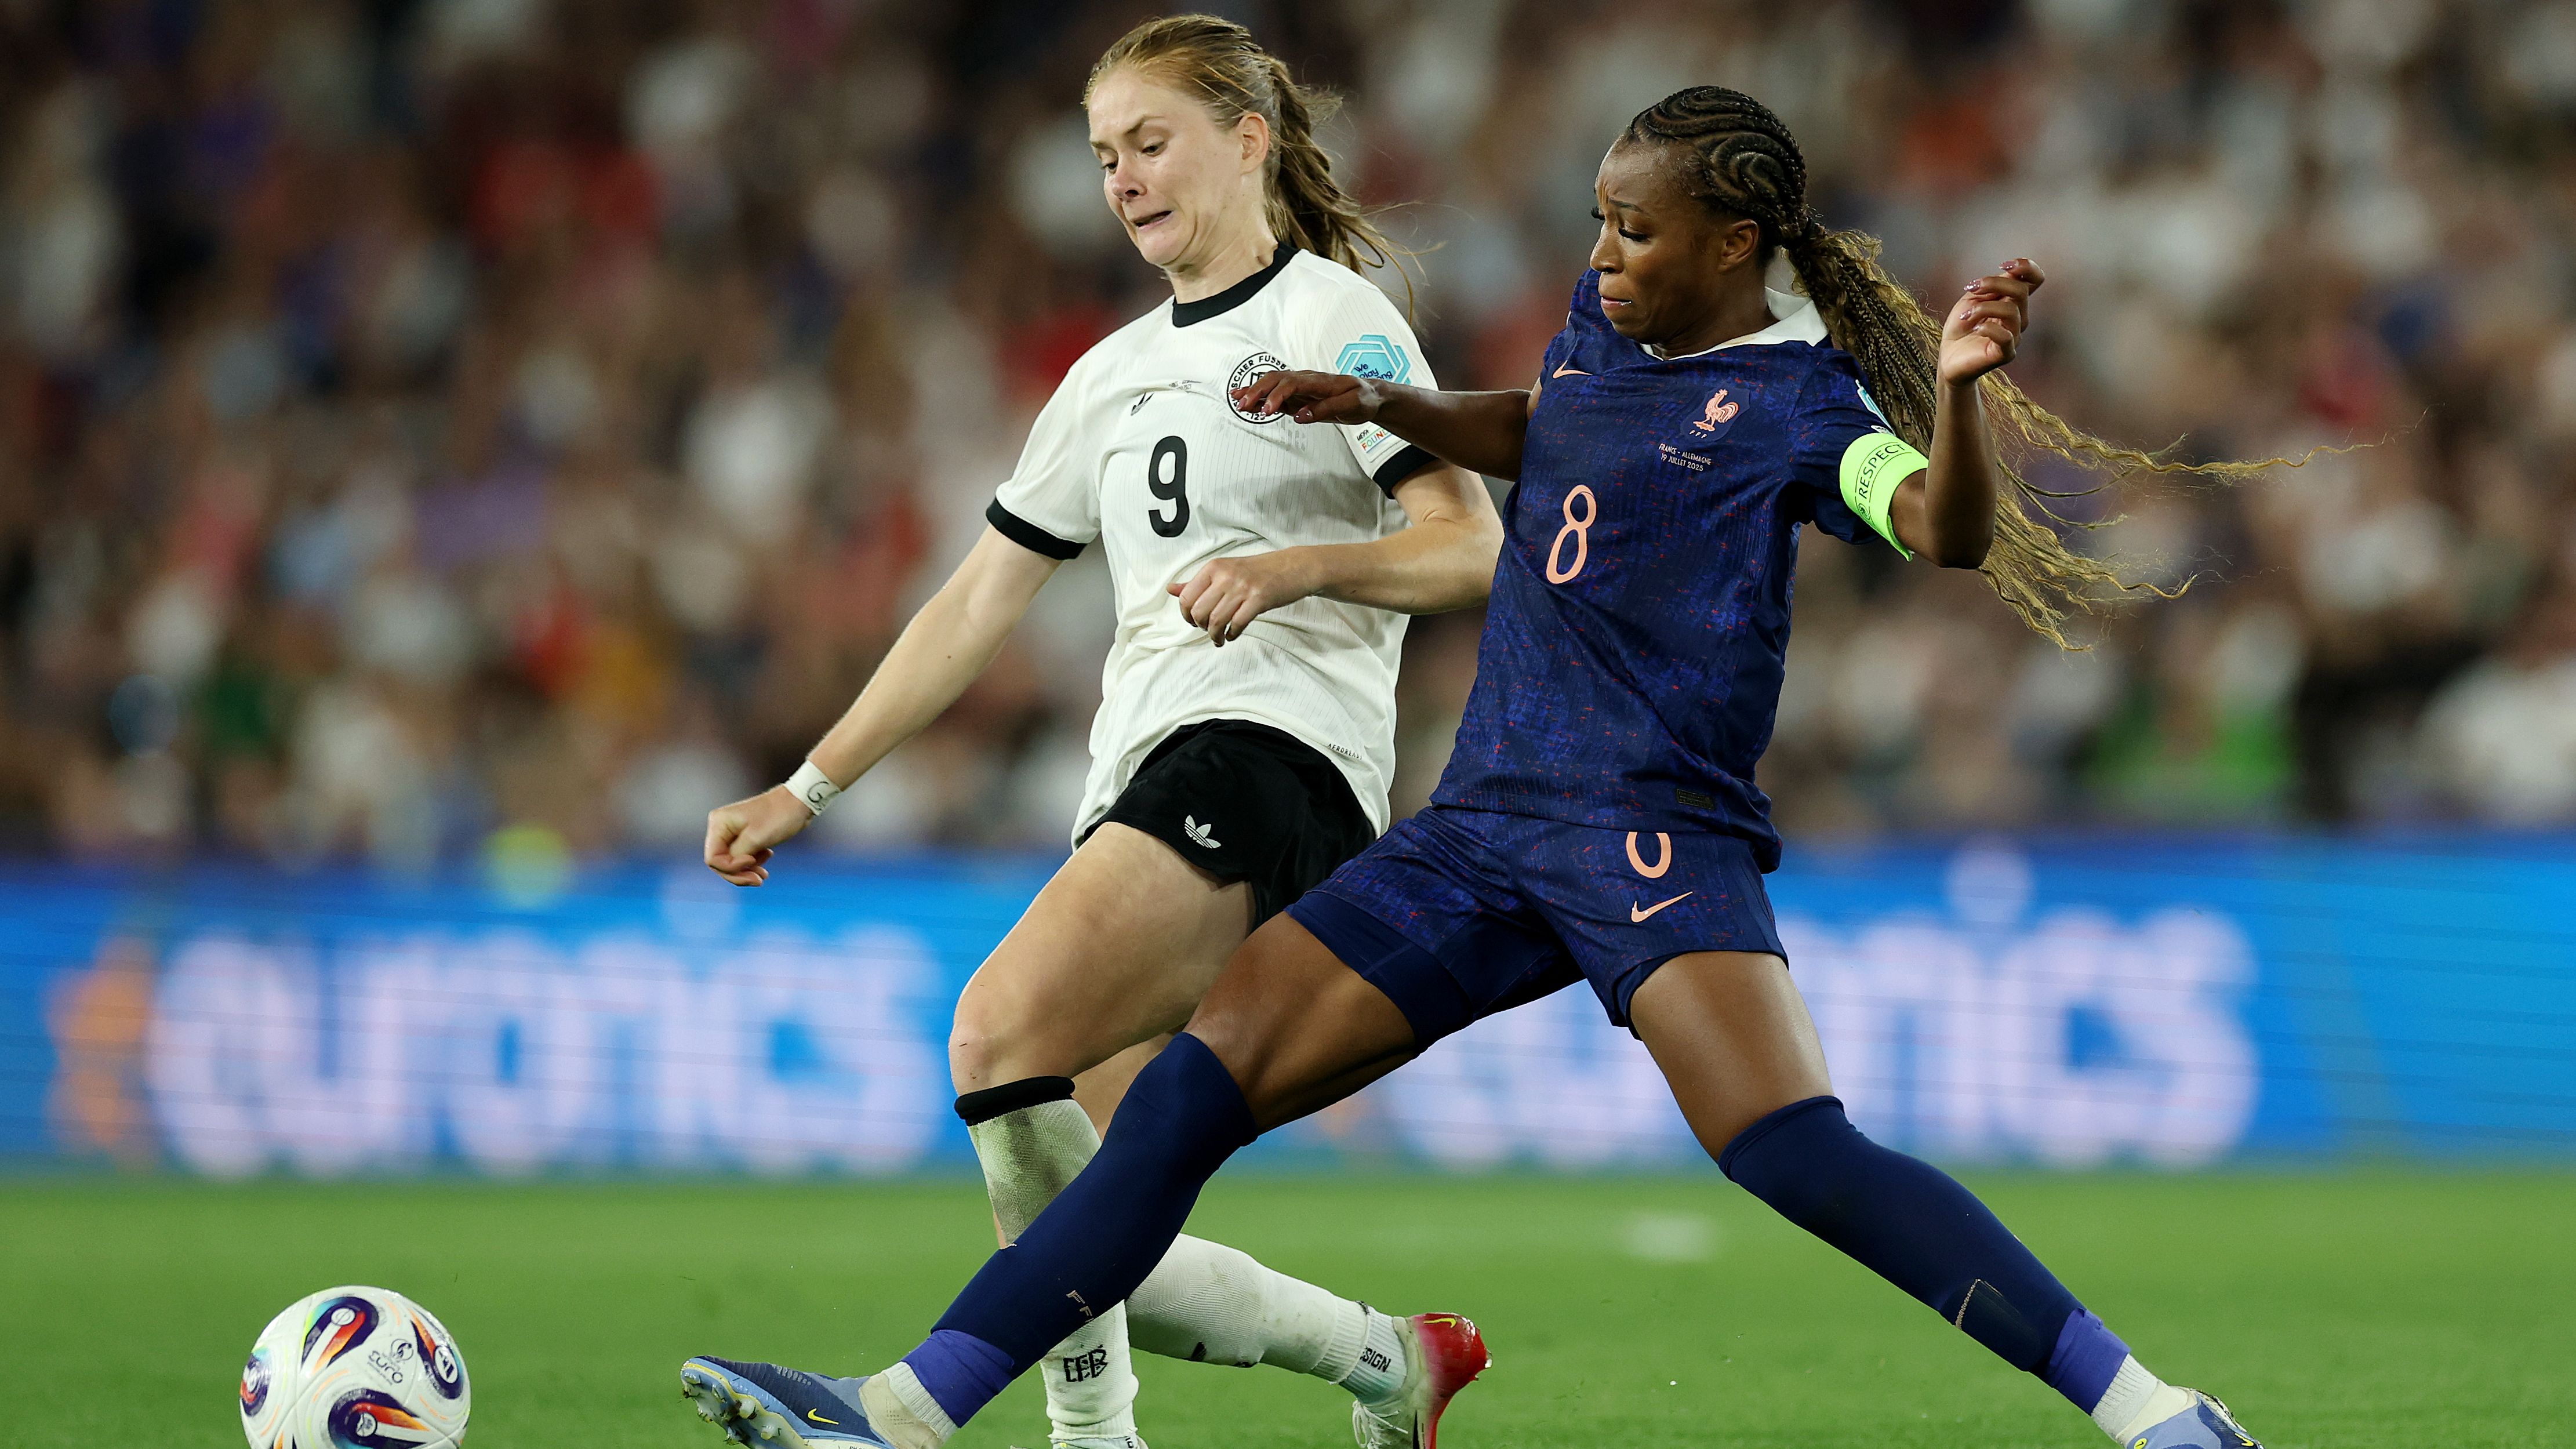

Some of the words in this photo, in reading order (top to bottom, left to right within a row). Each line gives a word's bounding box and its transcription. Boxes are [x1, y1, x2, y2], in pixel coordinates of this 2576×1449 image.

[1259, 355, 1287, 370] FUSSB
[1354, 364, 1368, 373] We
[1357, 429, 1369, 441] UEFA
[1690, 430, 1707, 438] FFF
[1659, 443, 1677, 455] FRANCE
[1681, 452, 1712, 465] ALLEMAGNE
[1661, 453, 1667, 462] 19
[1668, 456, 1687, 467] JUILLET
[1687, 462, 1703, 471] 2025
[1858, 444, 1905, 499] RESPECT
[1149, 436, 1190, 538] 9
[1546, 485, 1597, 584] 8
[1360, 1346, 1391, 1372] SIGN
